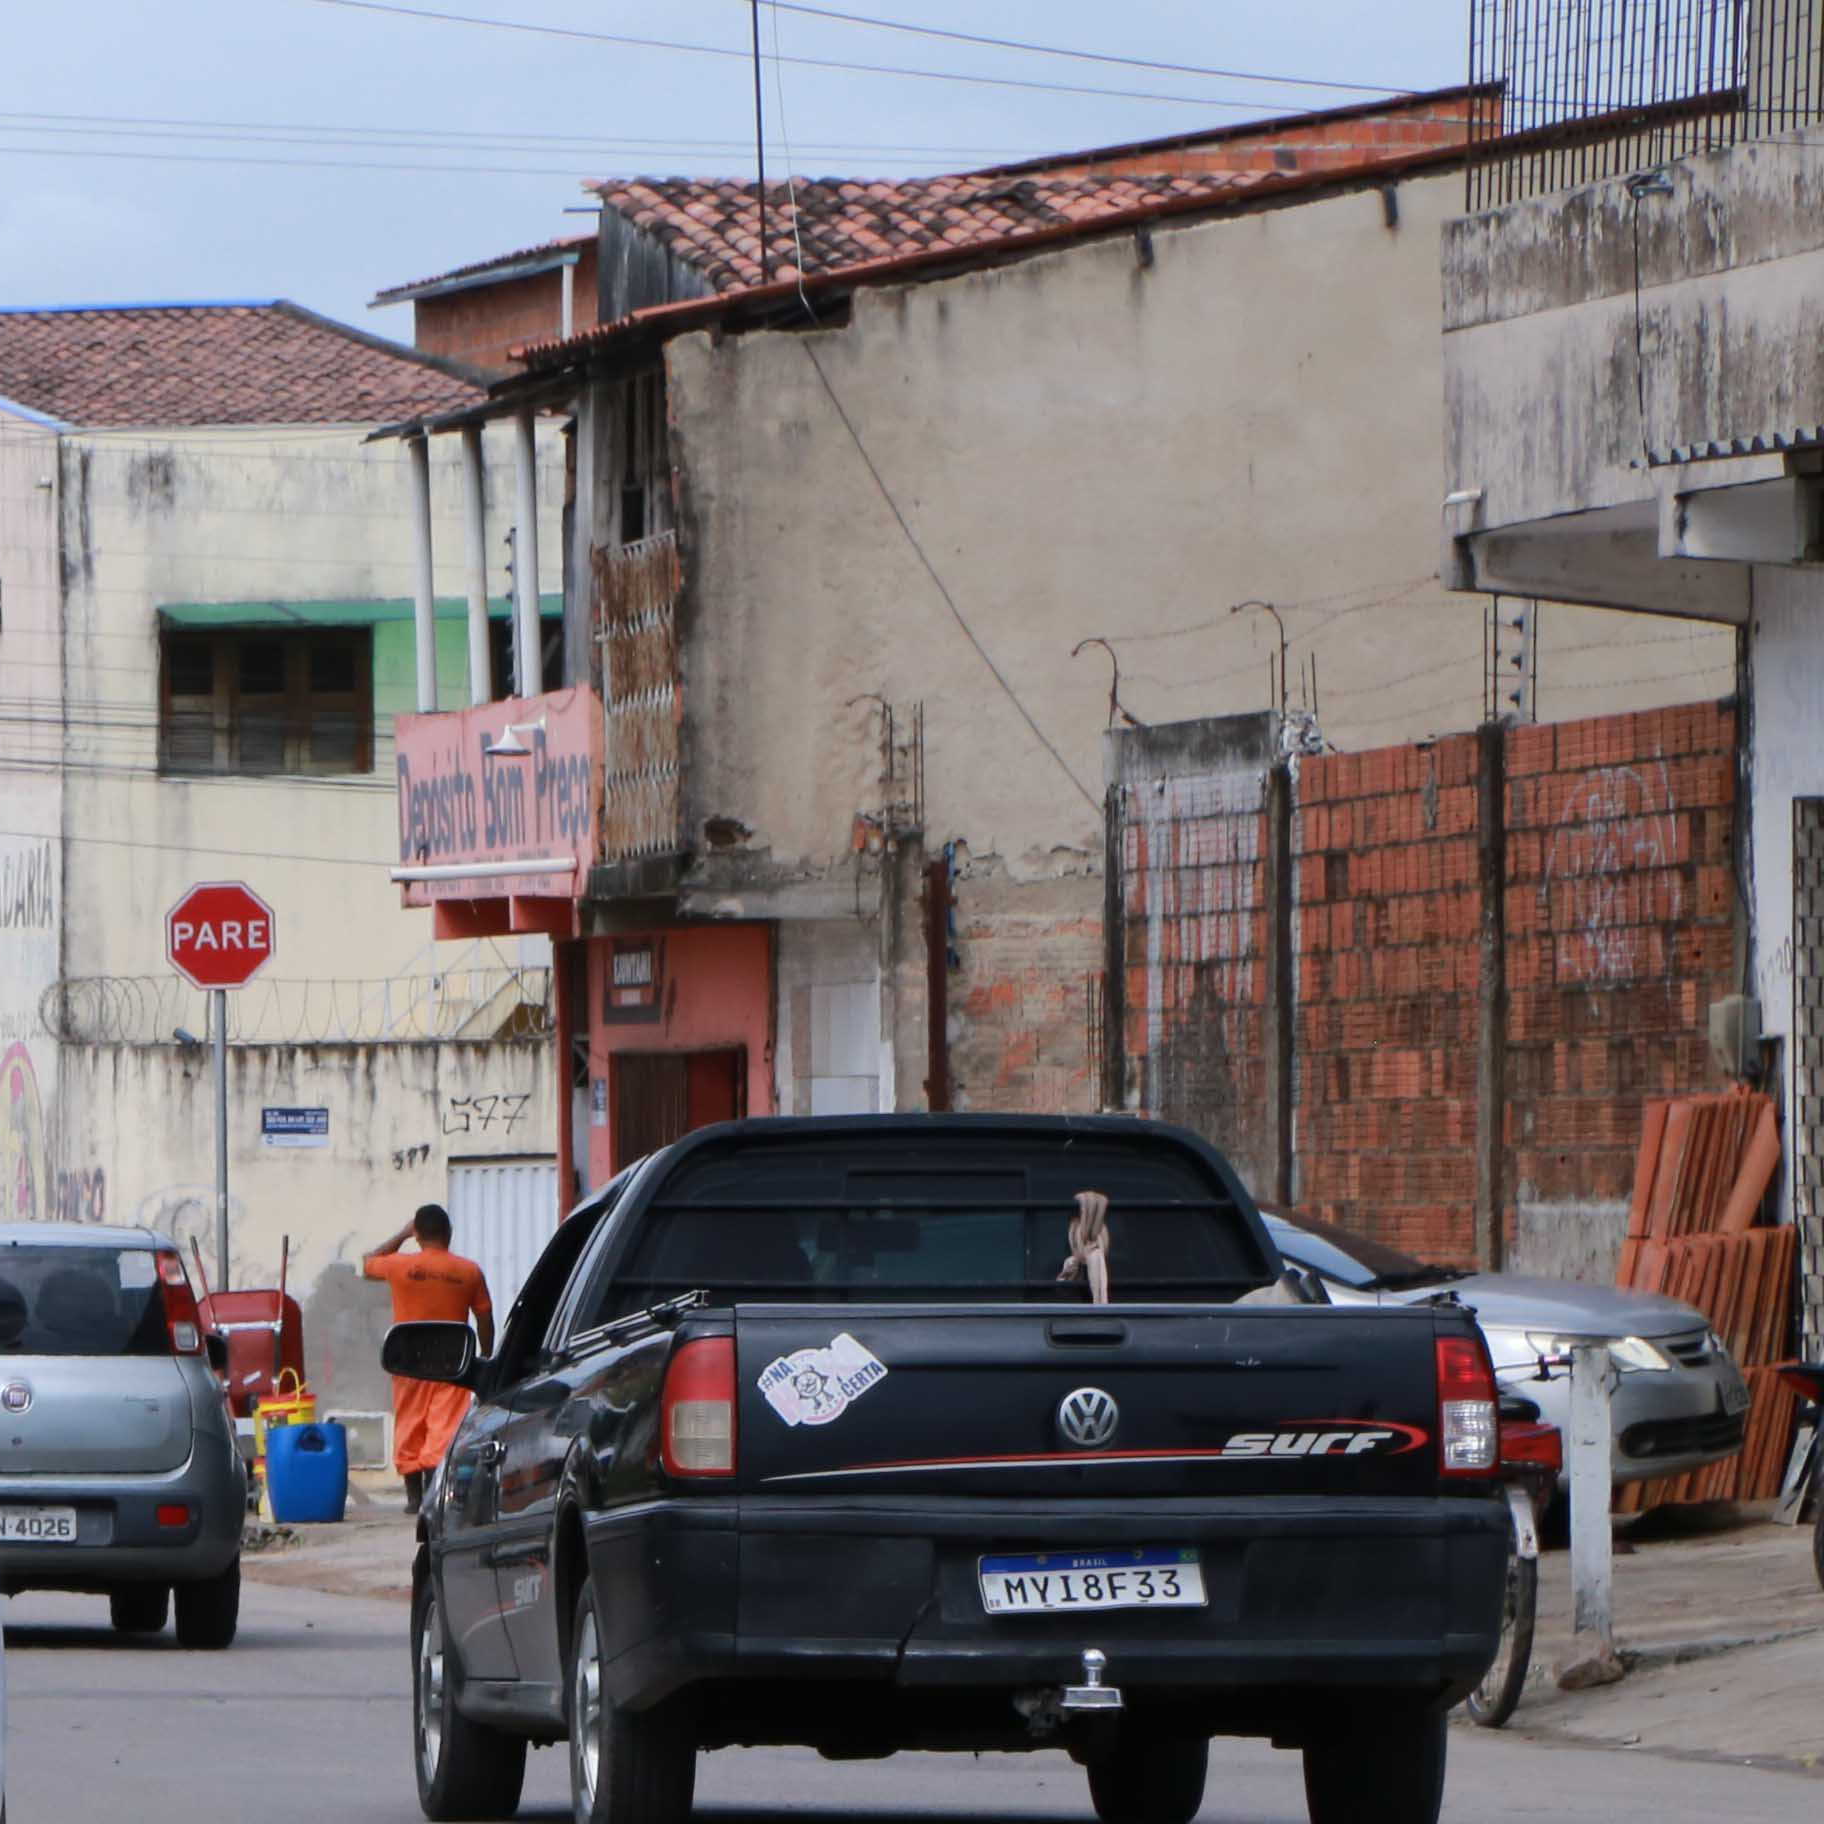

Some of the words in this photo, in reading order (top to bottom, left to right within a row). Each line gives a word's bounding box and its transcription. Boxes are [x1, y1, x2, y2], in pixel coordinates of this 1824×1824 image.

[479, 733, 526, 849] Bom
[533, 728, 593, 850] Preço
[174, 919, 267, 951] PARE
[443, 1095, 531, 1136] 577
[1072, 1559, 1107, 1569] BRASIL
[1004, 1569, 1182, 1605] MYI8F33
